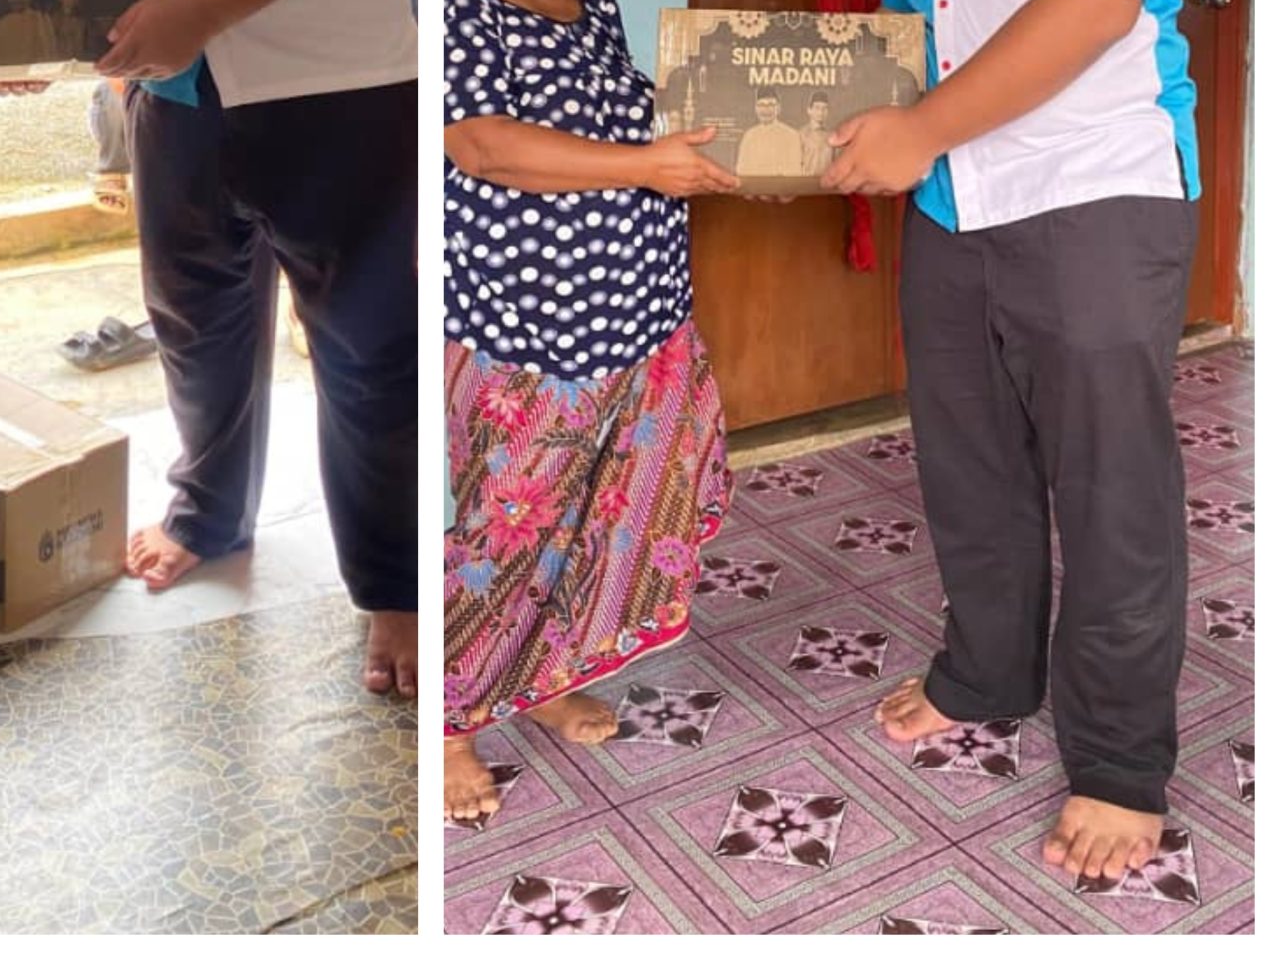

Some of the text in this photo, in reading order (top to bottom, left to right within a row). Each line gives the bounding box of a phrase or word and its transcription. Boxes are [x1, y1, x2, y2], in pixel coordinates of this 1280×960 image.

[731, 47, 854, 66] SINAR RAYA
[748, 67, 836, 86] MADANI
